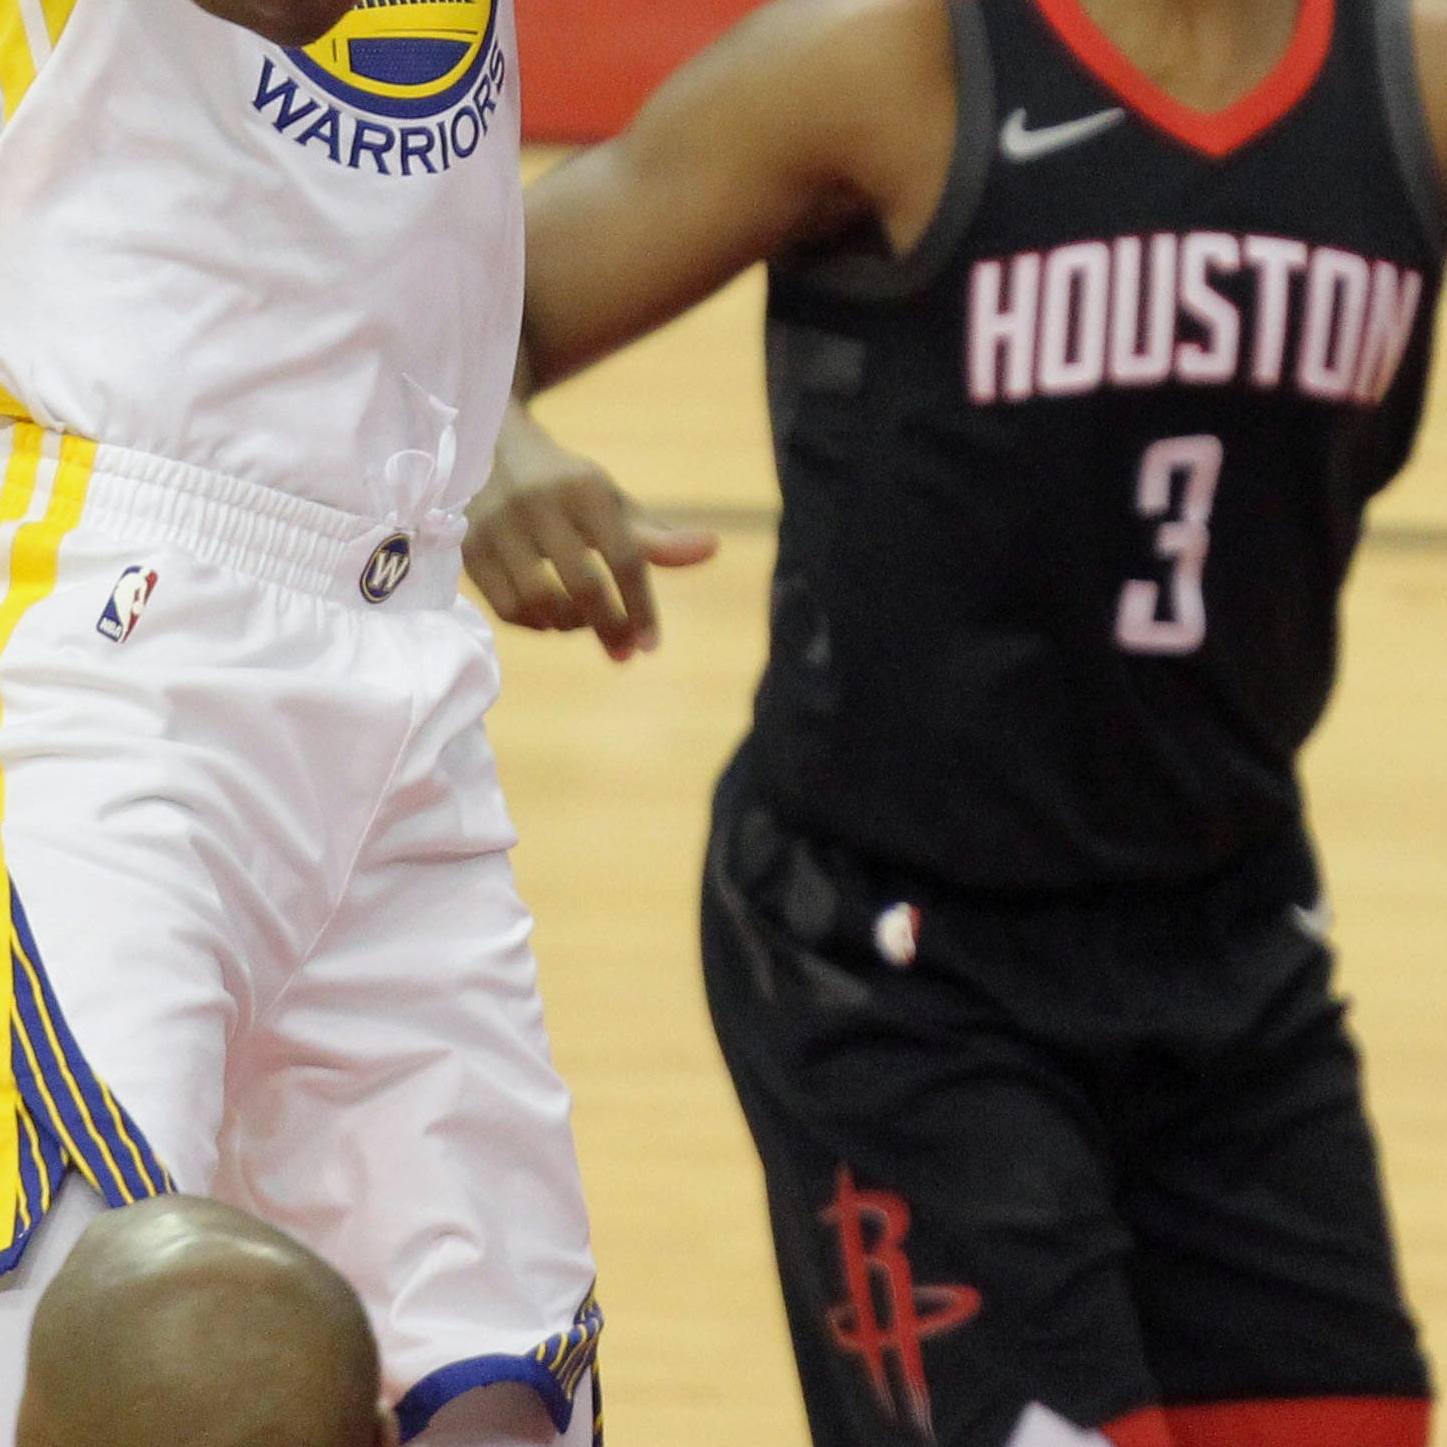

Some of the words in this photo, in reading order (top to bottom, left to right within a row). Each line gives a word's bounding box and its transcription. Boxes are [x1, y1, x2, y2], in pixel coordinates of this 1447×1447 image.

[252, 39, 506, 176] WARRIORS
[966, 229, 1423, 407] HOUSTON
[1113, 432, 1224, 656] 3
